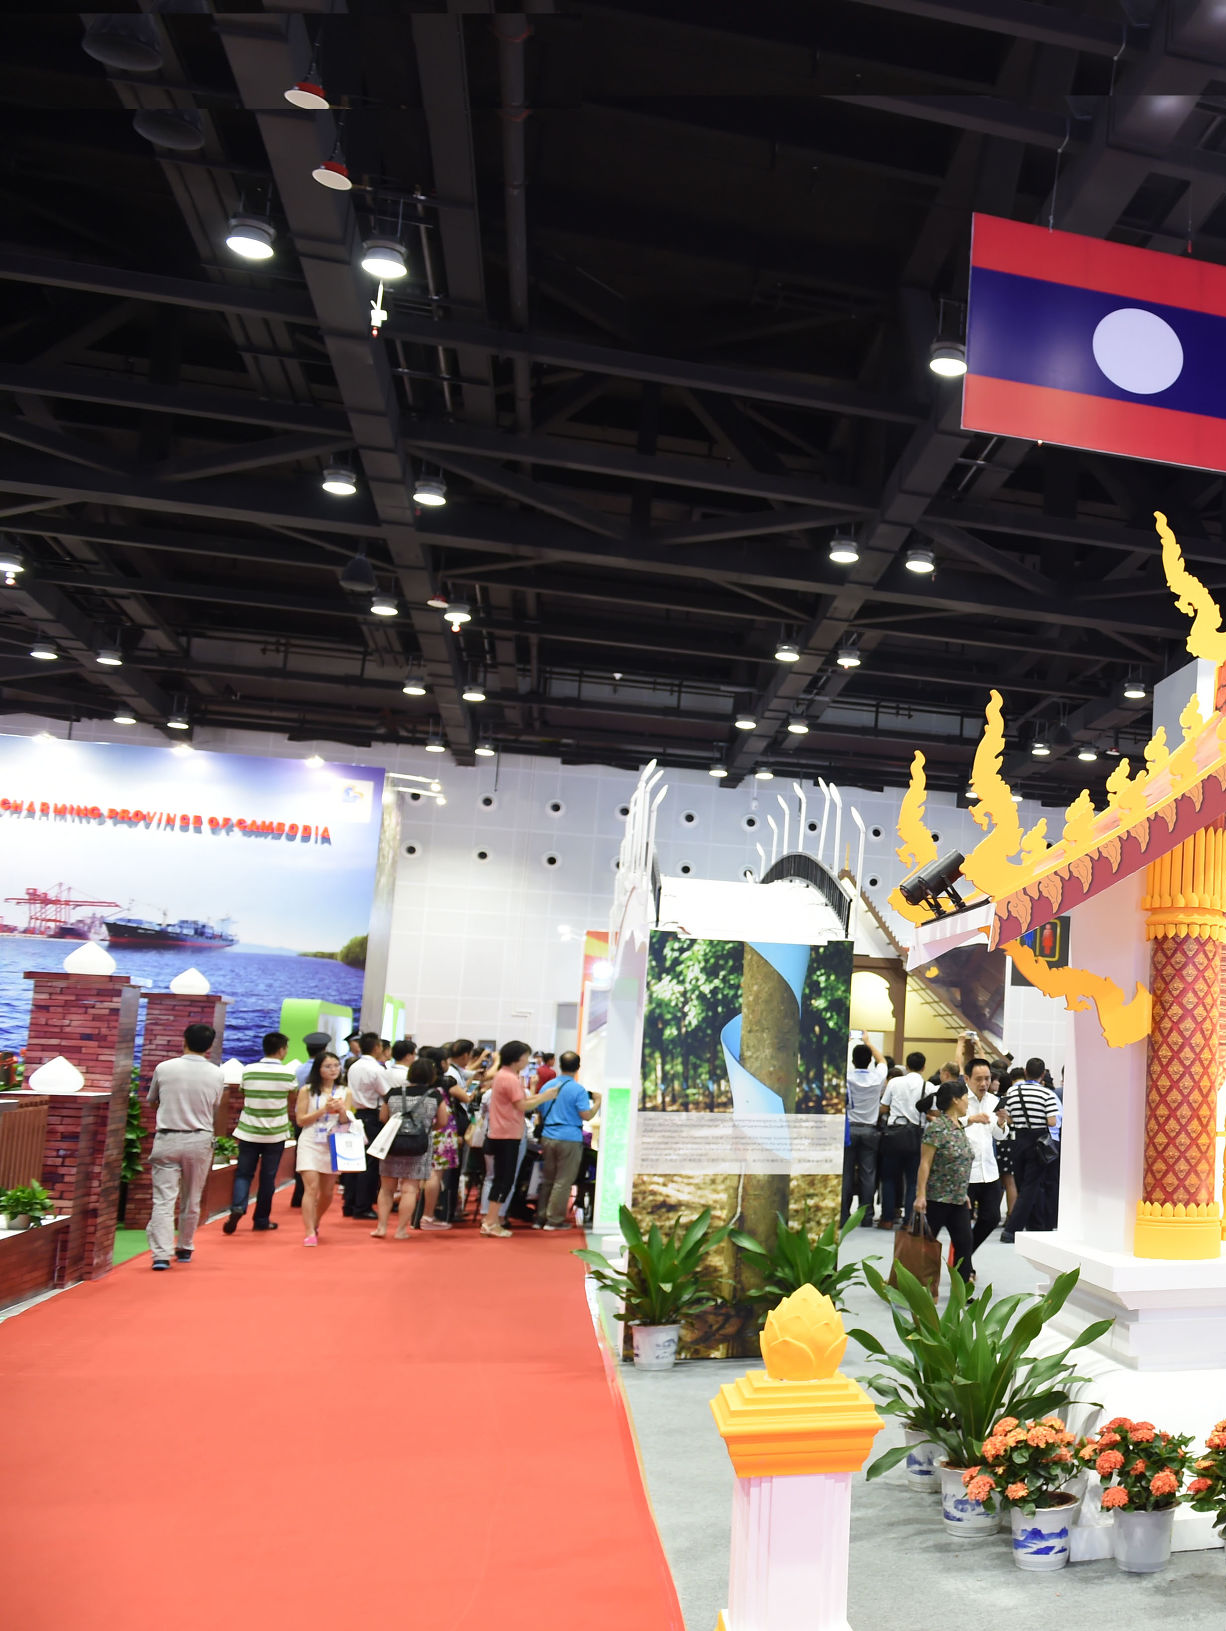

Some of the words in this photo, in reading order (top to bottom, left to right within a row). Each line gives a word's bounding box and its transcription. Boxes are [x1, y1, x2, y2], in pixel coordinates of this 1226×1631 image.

[0, 798, 102, 819] CHARMING
[106, 808, 203, 827] PROVINCE
[208, 816, 232, 829] OF
[234, 818, 330, 839] CAMBODIA
